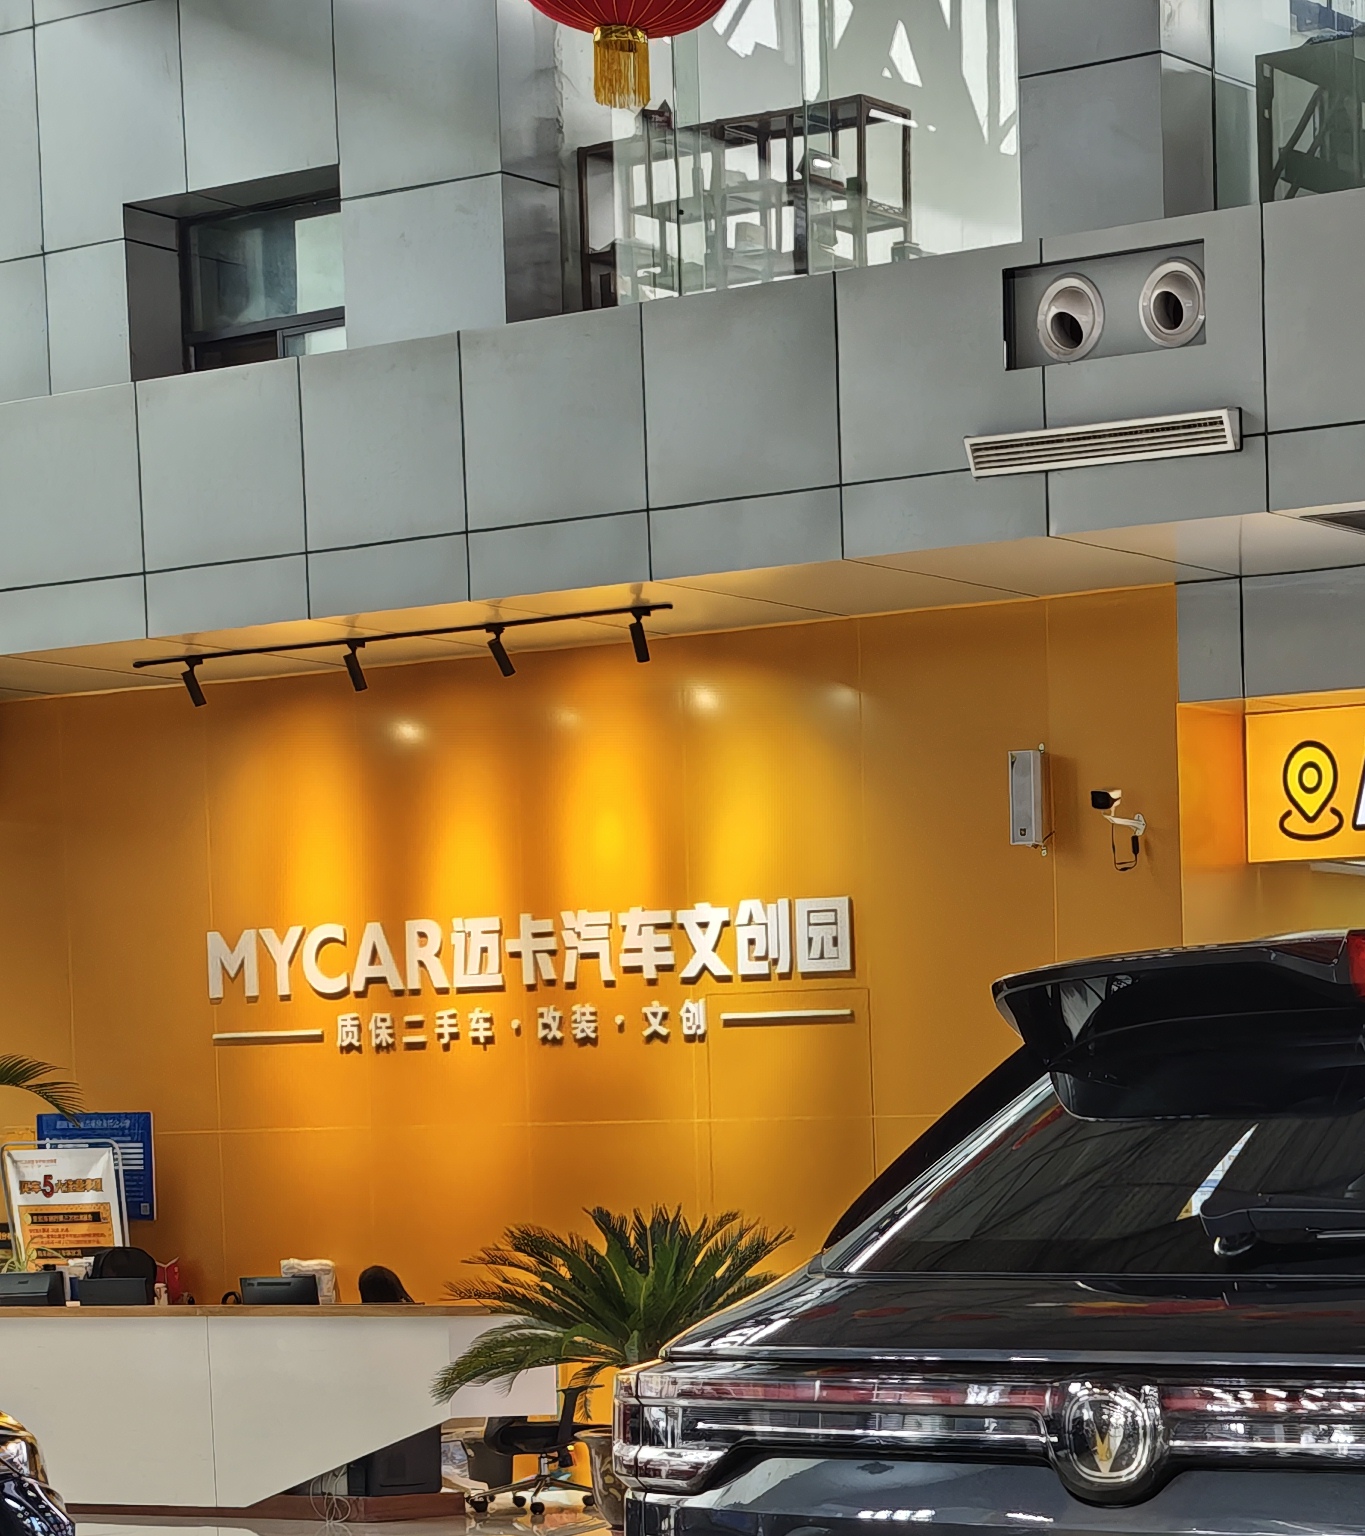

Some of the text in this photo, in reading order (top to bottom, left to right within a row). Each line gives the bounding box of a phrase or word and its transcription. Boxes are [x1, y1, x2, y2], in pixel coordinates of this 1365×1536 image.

[206, 896, 852, 1000] MYCAR迈卡汽车文创园
